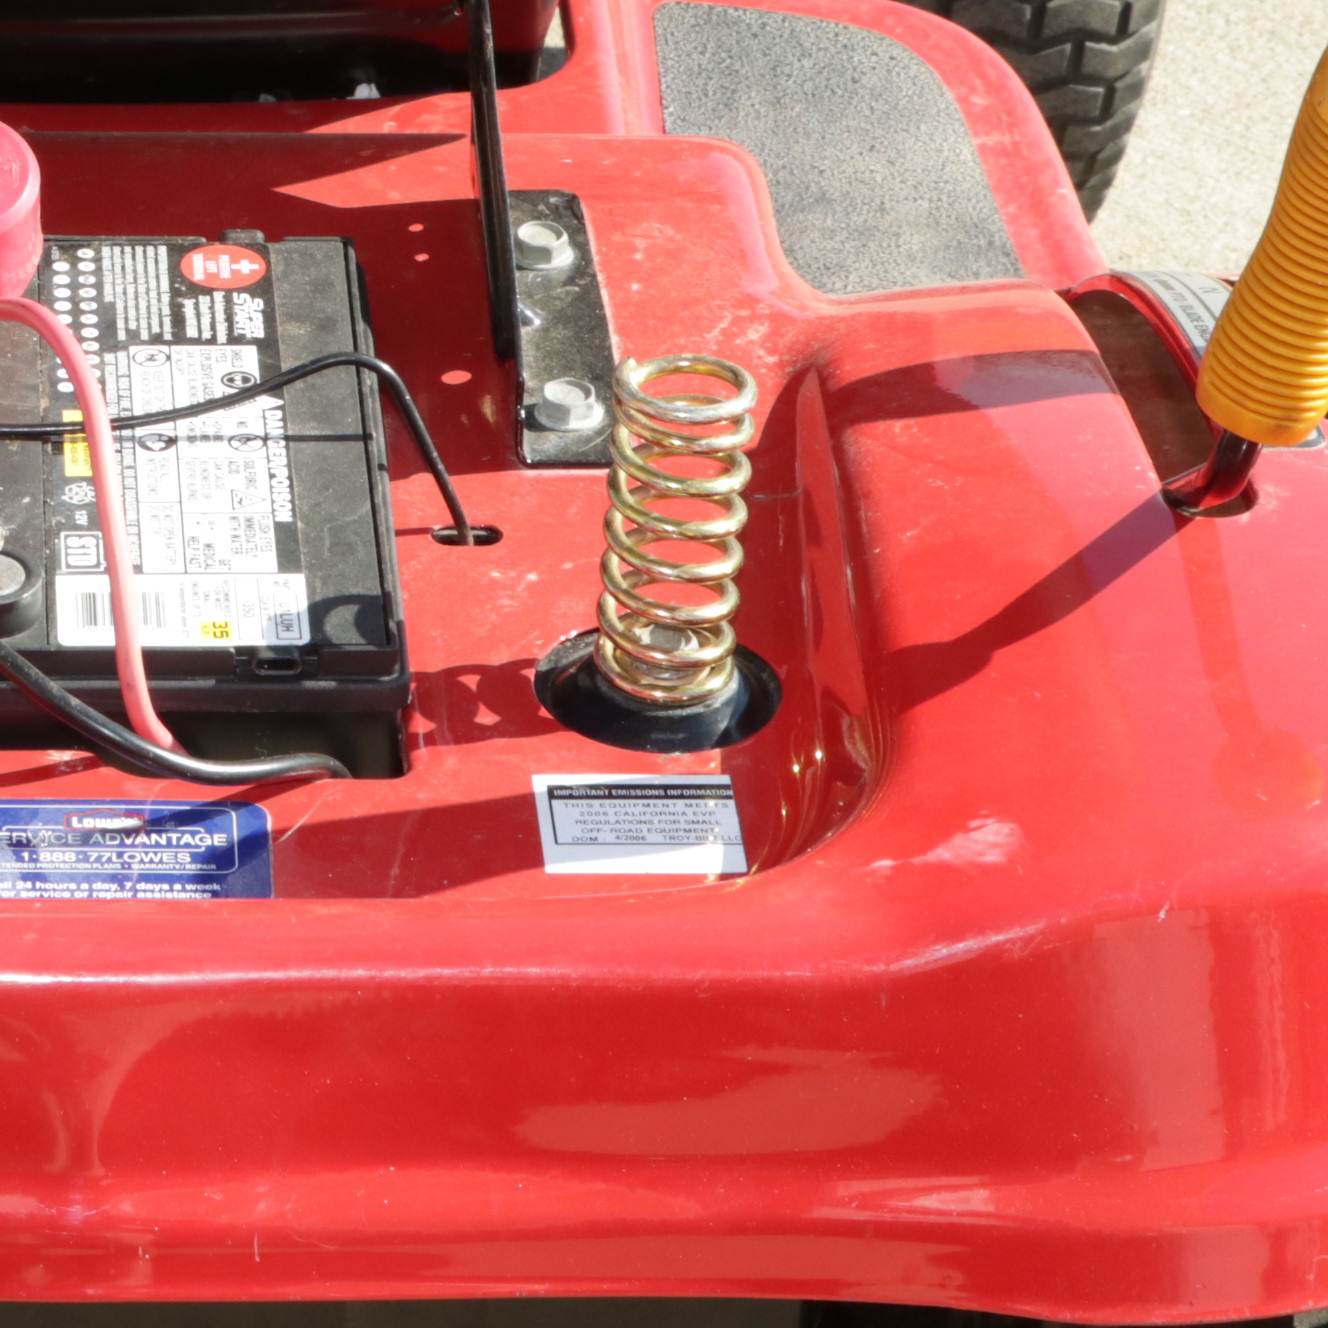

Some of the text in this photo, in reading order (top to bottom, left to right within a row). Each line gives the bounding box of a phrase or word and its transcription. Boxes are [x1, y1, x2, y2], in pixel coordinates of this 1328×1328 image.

[192, 253, 205, 281] TERMINAL
[205, 260, 218, 274] LEFT
[218, 254, 232, 279] POSITIVE
[232, 291, 252, 339] START
[252, 297, 265, 339] SUPER
[1179, 304, 1205, 325] BLADE
[200, 348, 214, 380] EXPLOSIVE
[230, 348, 244, 369] SHIELD
[228, 459, 240, 475] ACID
[243, 459, 258, 490] SULFURIC
[263, 409, 294, 522] DANGER/POISON
[75, 510, 89, 526] 12V
[228, 515, 242, 533] WITH
[243, 515, 258, 558] IMMEDIATELY
[258, 515, 273, 553] FLUSH EYES
[66, 536, 98, 567] STD
[187, 535, 200, 552] HELP
[203, 542, 217, 571] MEDICAL
[218, 558, 232, 571] GET
[242, 602, 255, 618] 350
[212, 621, 229, 639] 35
[553, 789, 610, 797] IMPORTANT
[612, 789, 666, 797] EMISSIONS
[71, 816, 142, 829] Low
[88, 833, 228, 846] ADVANTAGE
[36, 862, 92, 870] PROTECTION
[15, 880, 33, 890] 24
[35, 881, 77, 890] hours
[91, 881, 120, 891] day,
[123, 882, 133, 890] 7
[135, 882, 171, 891] days
[185, 882, 221, 891] week
[19, 890, 72, 898] service
[92, 891, 133, 899] repair
[136, 891, 212, 899] assistance
